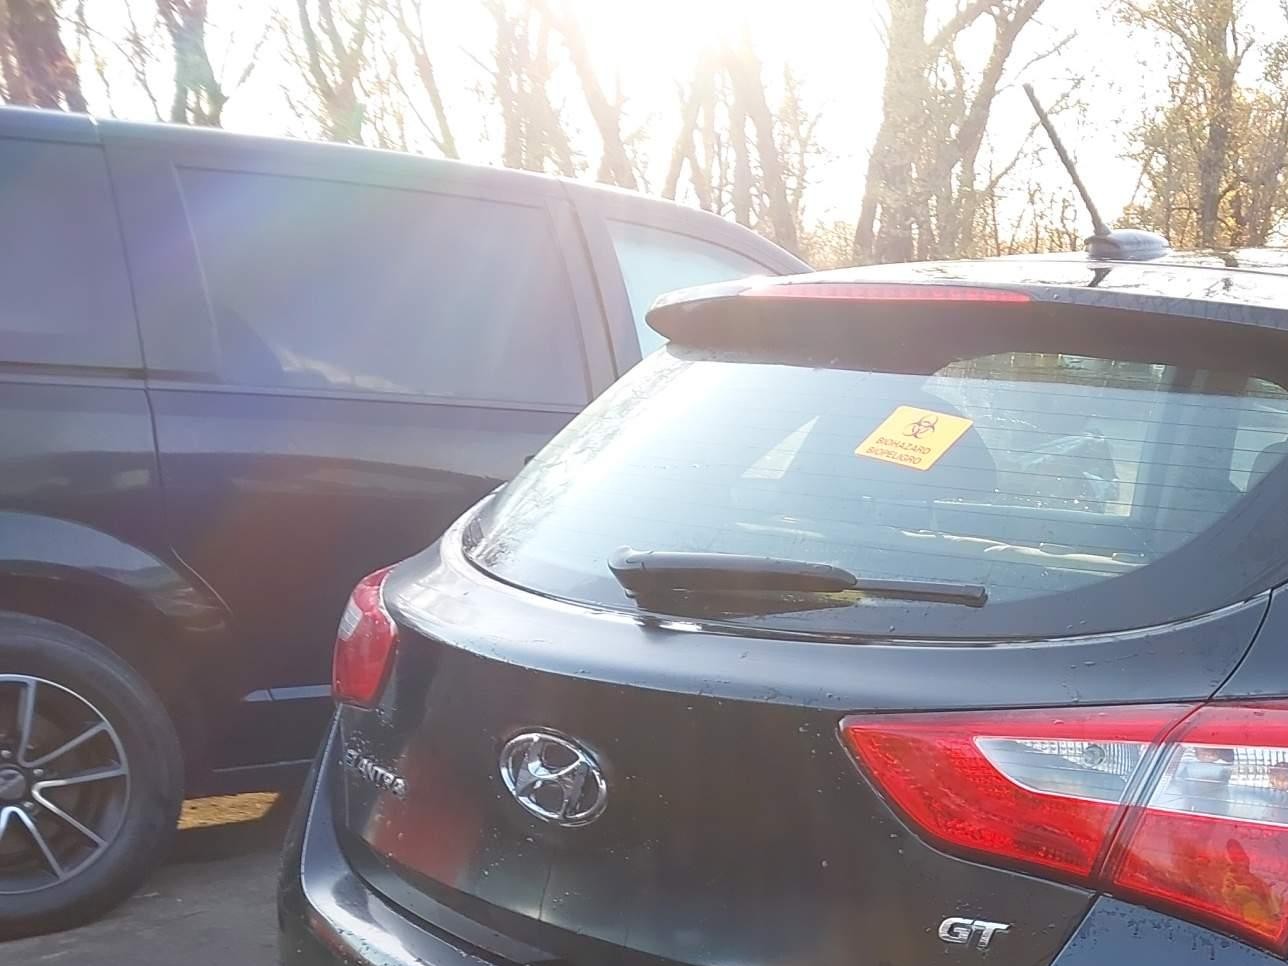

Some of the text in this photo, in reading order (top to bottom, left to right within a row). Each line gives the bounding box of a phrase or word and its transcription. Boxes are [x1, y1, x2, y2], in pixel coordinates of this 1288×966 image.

[865, 445, 923, 465] BIOPELIGRO
[875, 436, 932, 456] BIOHAZARD
[938, 916, 1011, 949] GT
